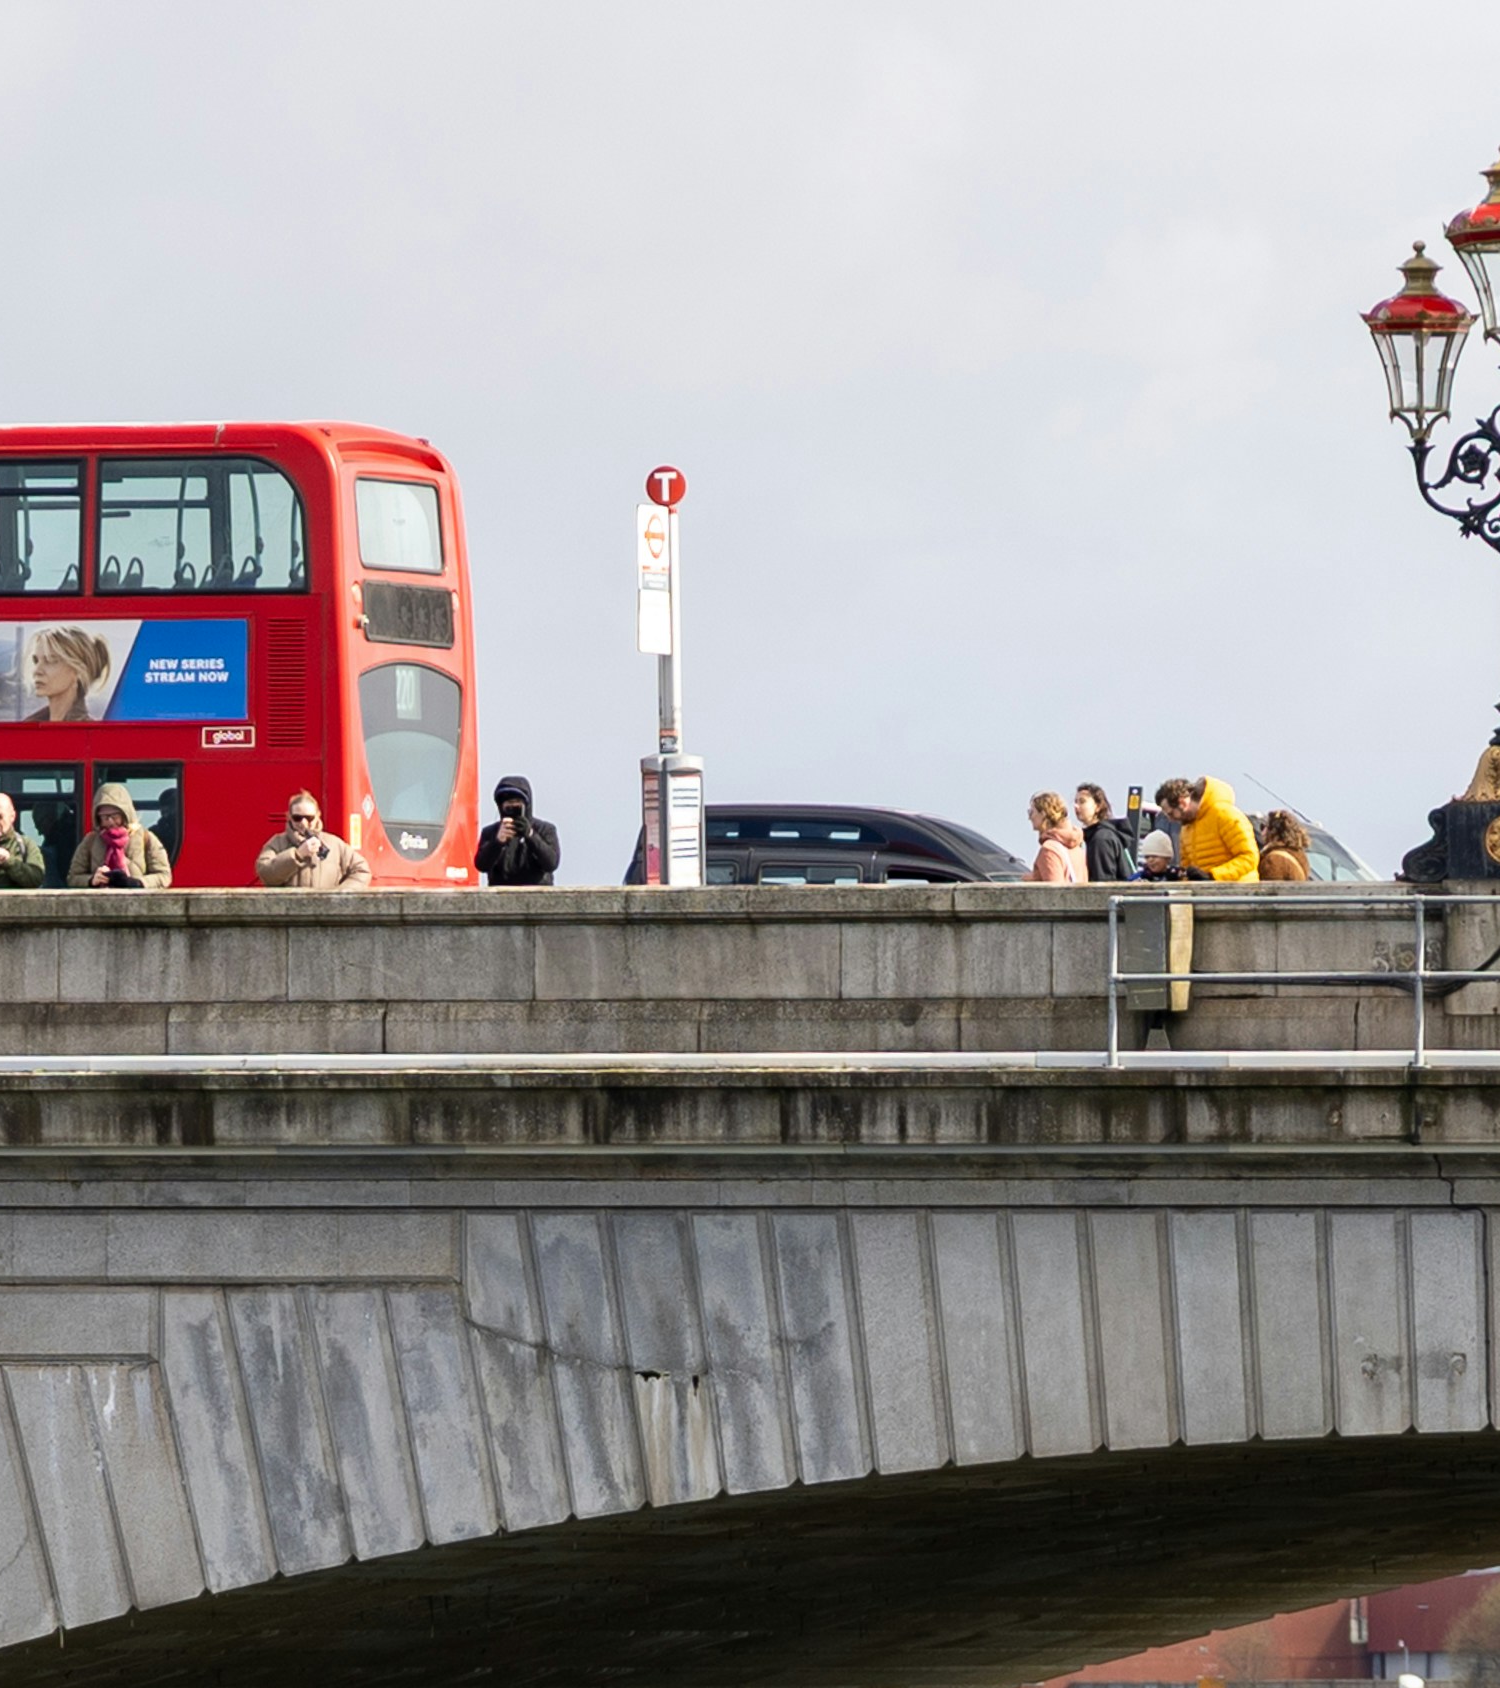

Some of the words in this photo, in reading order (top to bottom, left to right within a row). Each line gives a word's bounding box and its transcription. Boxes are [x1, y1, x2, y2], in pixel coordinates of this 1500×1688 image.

[654, 472, 677, 502] T
[149, 658, 179, 671] NEW
[181, 658, 225, 670] SERIES
[144, 672, 196, 684] STREAM
[198, 671, 229, 683] NOW
[212, 730, 245, 745] global
